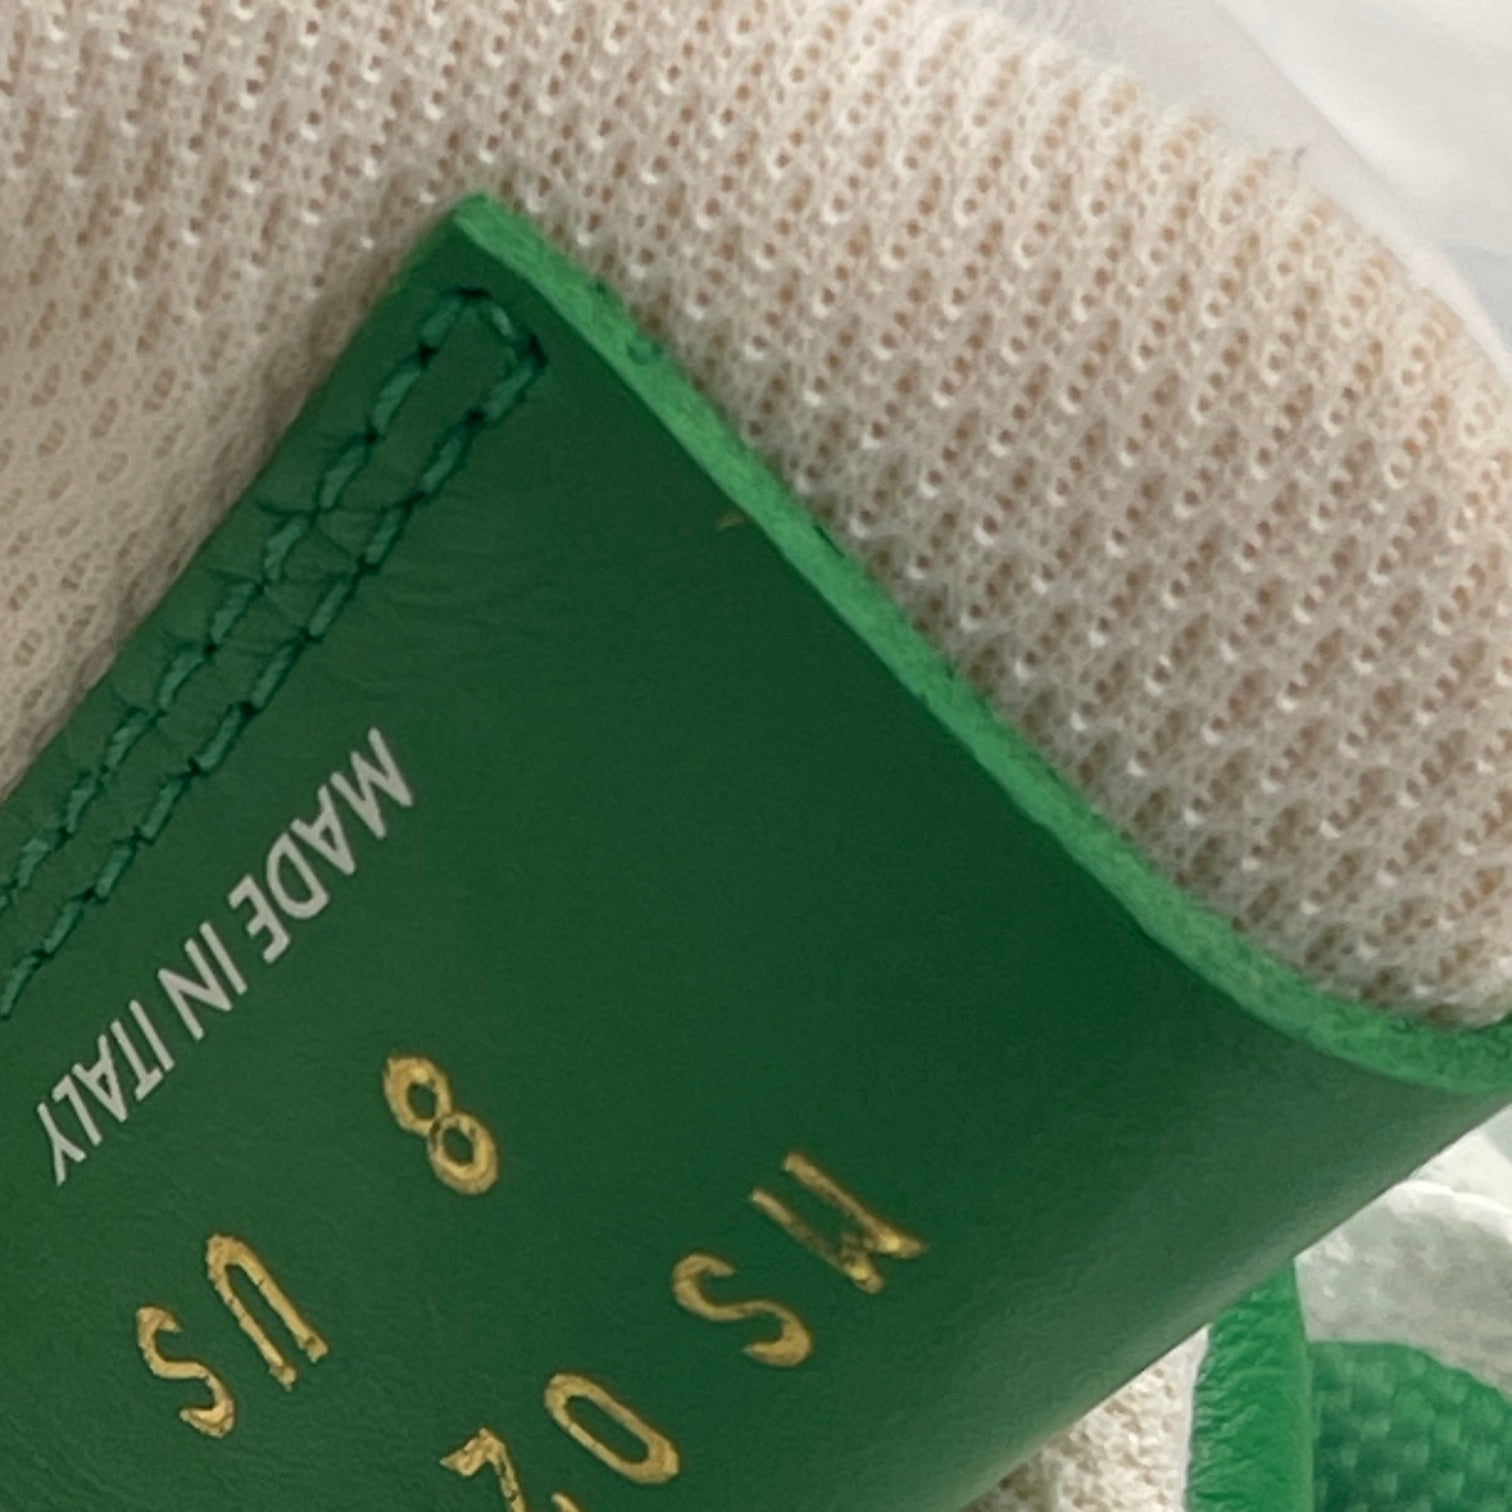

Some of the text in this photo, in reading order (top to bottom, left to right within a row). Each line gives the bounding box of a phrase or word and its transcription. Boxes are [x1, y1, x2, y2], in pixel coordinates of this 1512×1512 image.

[36, 726, 414, 1187] MADE IN ITALY
[136, 1053, 499, 1438] 8 US
[672, 1150, 929, 1368] MS
